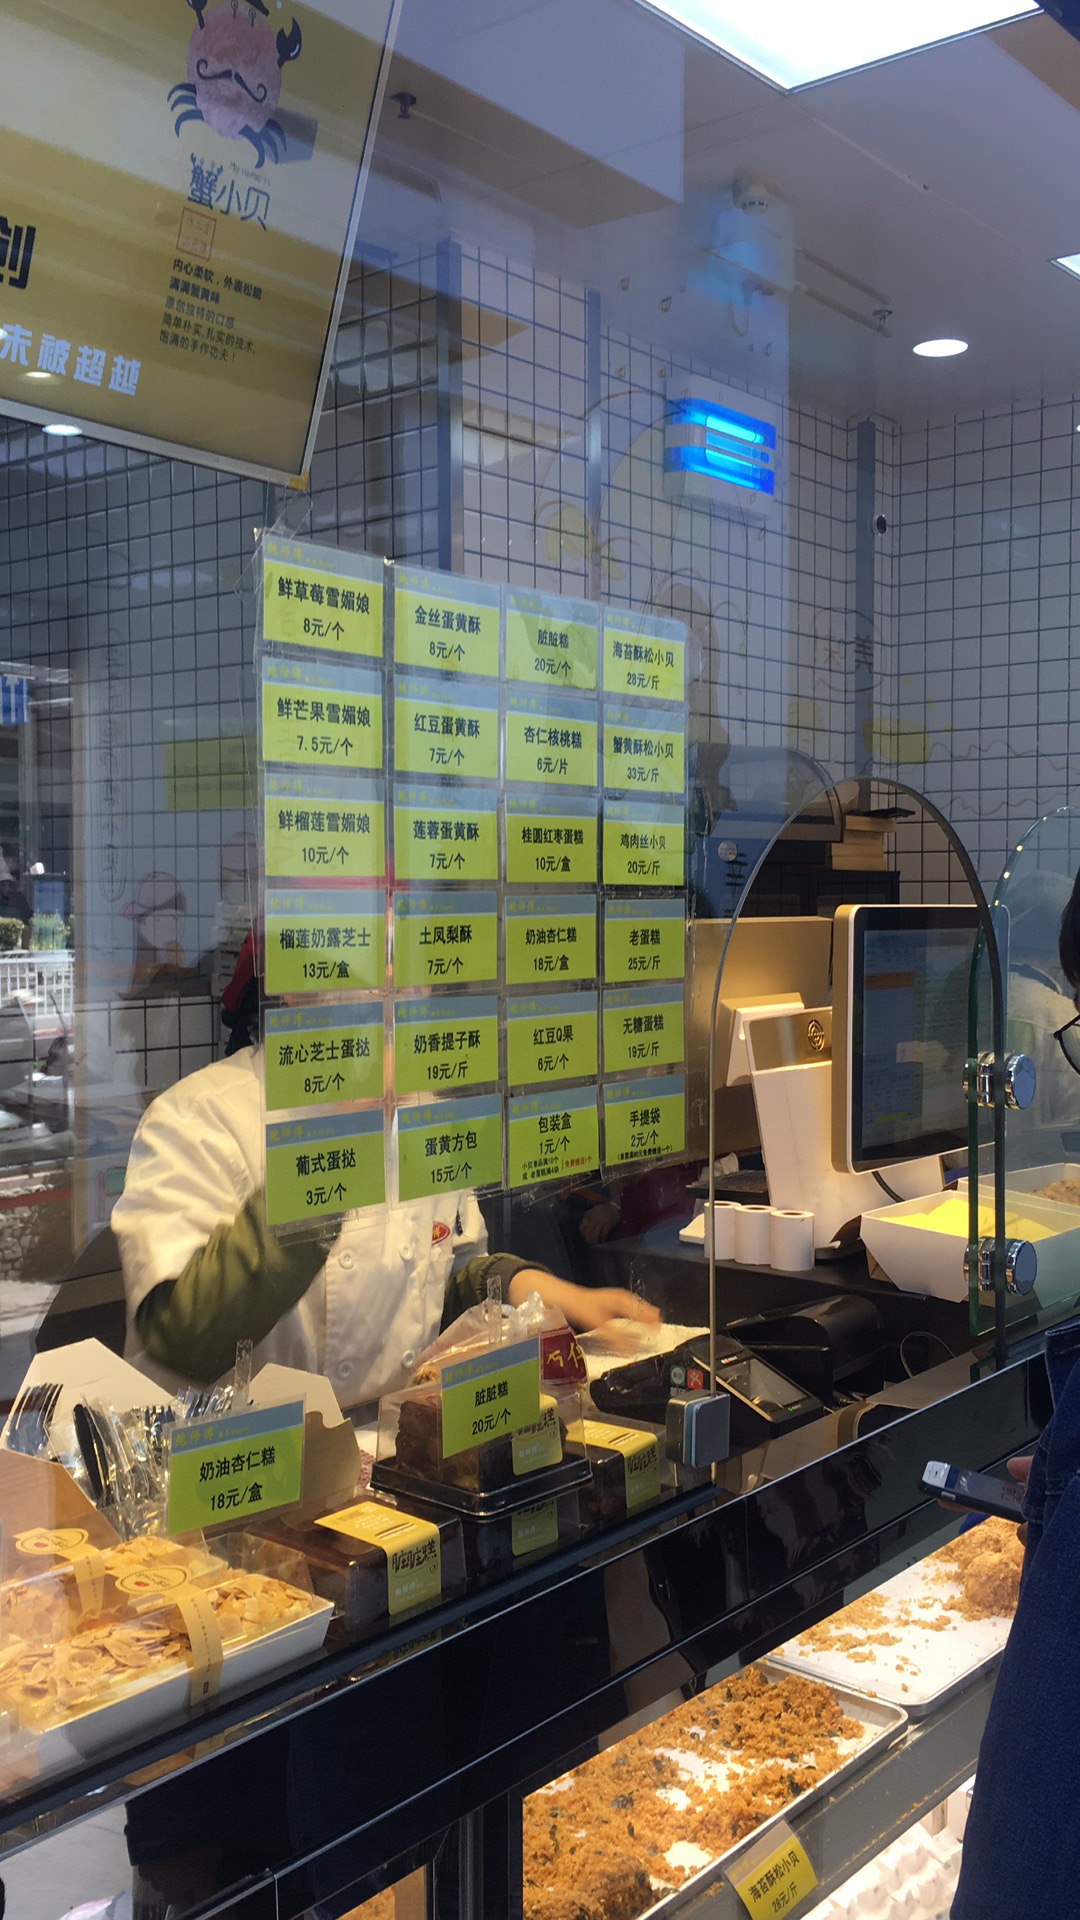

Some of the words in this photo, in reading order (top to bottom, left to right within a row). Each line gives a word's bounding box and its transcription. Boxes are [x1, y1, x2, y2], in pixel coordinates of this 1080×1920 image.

[187, 153, 270, 231] 蟹小贝
[278, 576, 370, 615] 鲜草莓雪媚娘
[304, 618, 344, 641] 8元/个
[415, 605, 481, 635] 金丝蛋黄酥
[538, 630, 569, 649] 脏脏糕
[430, 642, 465, 662] 8元/个
[613, 641, 674, 668] 海苔酥松小贝
[535, 658, 572, 678] 20元/个
[627, 672, 659, 690] 28元/斤
[277, 698, 371, 727] 鲜芒果雪媚娘
[414, 714, 480, 738] 红豆蛋黄酥
[297, 736, 353, 756] 7.5元/个
[524, 726, 582, 749] 杏仁核桃糕
[613, 736, 673, 758] 蟹黄酥松小贝
[430, 748, 465, 766] 7元/个
[537, 758, 568, 775] 6元/片
[627, 767, 659, 783] 33元/斤
[278, 810, 370, 833] 鲜榴莲雪媚娘
[414, 820, 479, 842] 莲蓉蛋黄酥
[522, 827, 583, 845] 桂圆红枣蛋糕
[620, 833, 665, 850] 鸡肉丝小贝
[302, 846, 349, 864] 10元/个
[430, 853, 465, 870] 7元/个
[536, 856, 571, 872] 10元/盒
[628, 860, 660, 876] 20元/斤
[280, 928, 371, 950] 榴莲奶露芝士
[420, 925, 472, 945] 土凤梨酥
[526, 927, 577, 945] 奶油杏仁糕
[630, 929, 660, 946] 老蛋糕
[303, 961, 350, 979] 13元/盒
[428, 957, 463, 975] 7元/个
[534, 954, 569, 972] 18元/盒
[628, 955, 661, 971] 25元/斤
[623, 1014, 664, 1035] 无糖蛋糕
[414, 1030, 481, 1054] 奶香提子酥
[534, 1025, 573, 1045] 红豆Q果
[279, 1038, 370, 1066] 流心芝士蛋挞
[628, 1041, 659, 1059] 19元/斤
[428, 1061, 468, 1080] 19元/斤
[538, 1054, 569, 1072] 6元/个
[304, 1072, 345, 1094] 8元/个
[538, 1112, 571, 1133] 包装盒
[630, 1108, 660, 1127] 手提袋
[425, 1131, 477, 1157] 蛋黄方包
[540, 1136, 570, 1155] 1元/个
[631, 1130, 659, 1147] 2元/个
[296, 1148, 356, 1177] 葡式蛋挞
[431, 1162, 472, 1183] 15元/个
[306, 1183, 347, 1206] 3元/个
[475, 1380, 509, 1407] 脏脏糕
[472, 1408, 511, 1437] 20元/个
[200, 1445, 276, 1484] 奶油杏仁糕
[209, 1482, 263, 1511] 18元/盒
[748, 1850, 800, 1902] 海苔酥松小贝
[772, 1881, 799, 1913] 28元/斤
